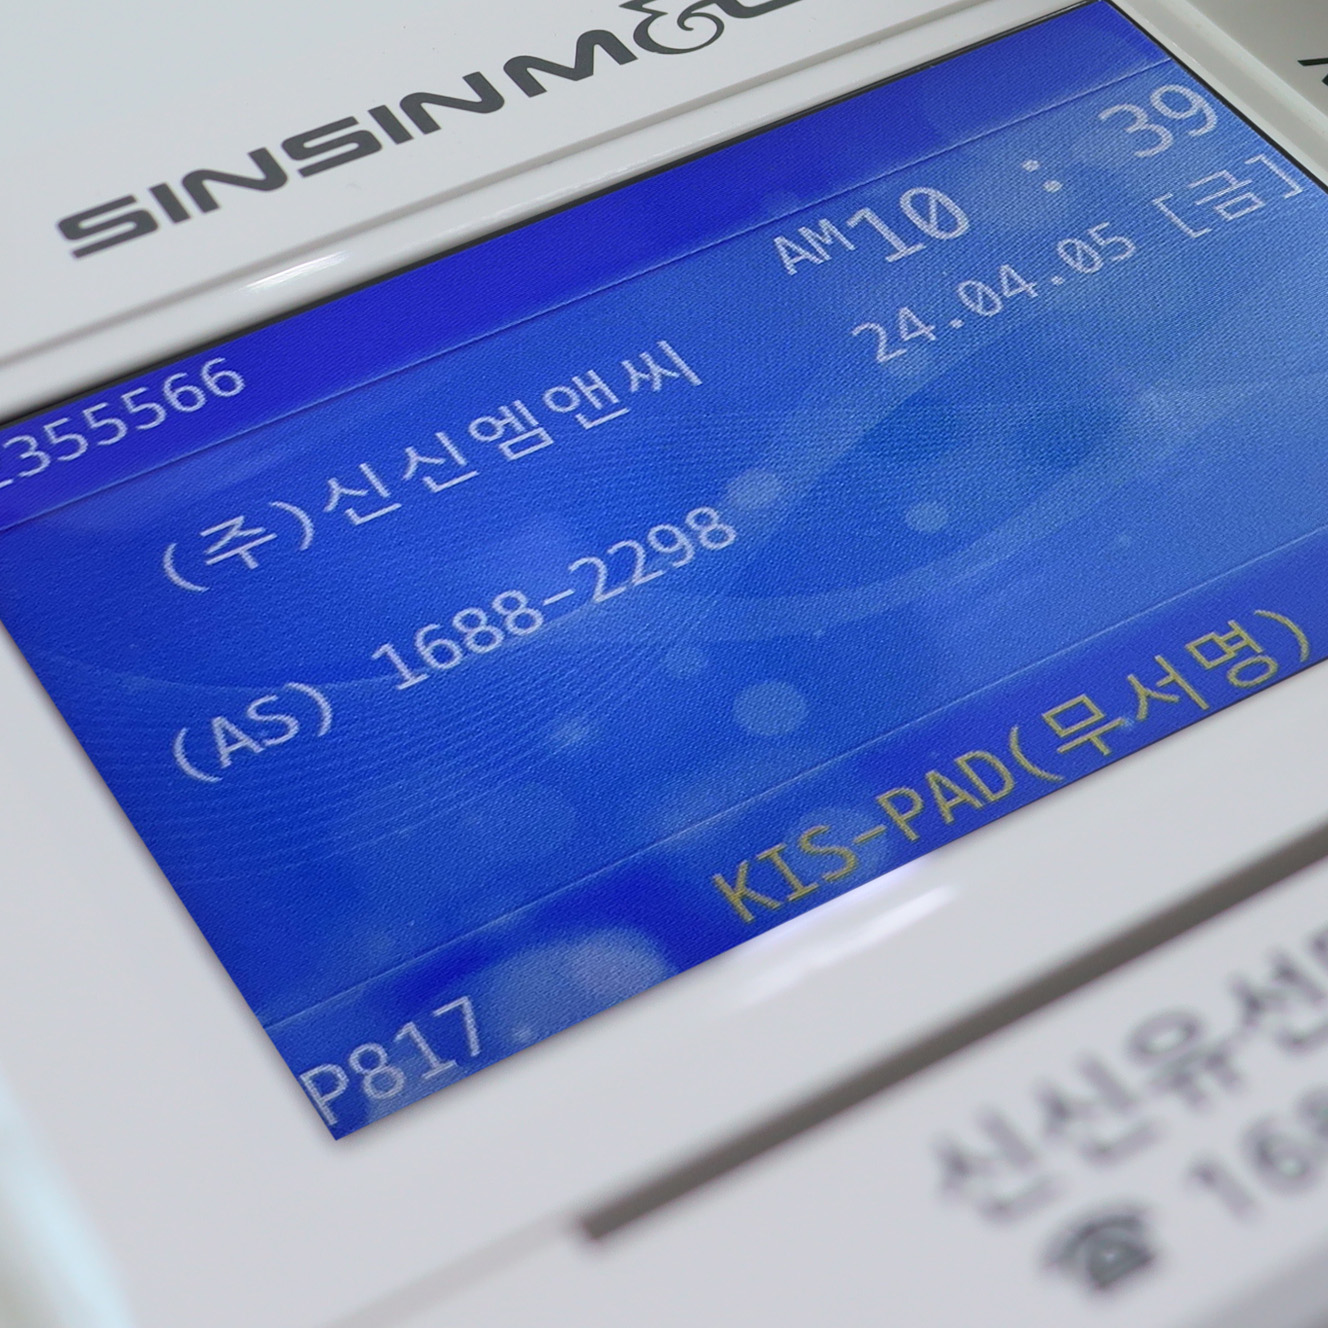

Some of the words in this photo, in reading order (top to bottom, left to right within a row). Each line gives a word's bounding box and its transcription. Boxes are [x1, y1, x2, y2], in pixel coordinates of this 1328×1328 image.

[1099, 83, 1220, 158] 39
[850, 221, 1137, 364] 24.04.05
[1151, 153, 1304, 239] [금]
[0, 356, 246, 490] 355566
[161, 339, 704, 593] (주)신신엠앤씨
[171, 679, 334, 783] (AS)
[370, 505, 738, 691] 1688-2298
[711, 608, 1312, 924] KIS-PAD(무서명)
[298, 994, 482, 1127] P817
